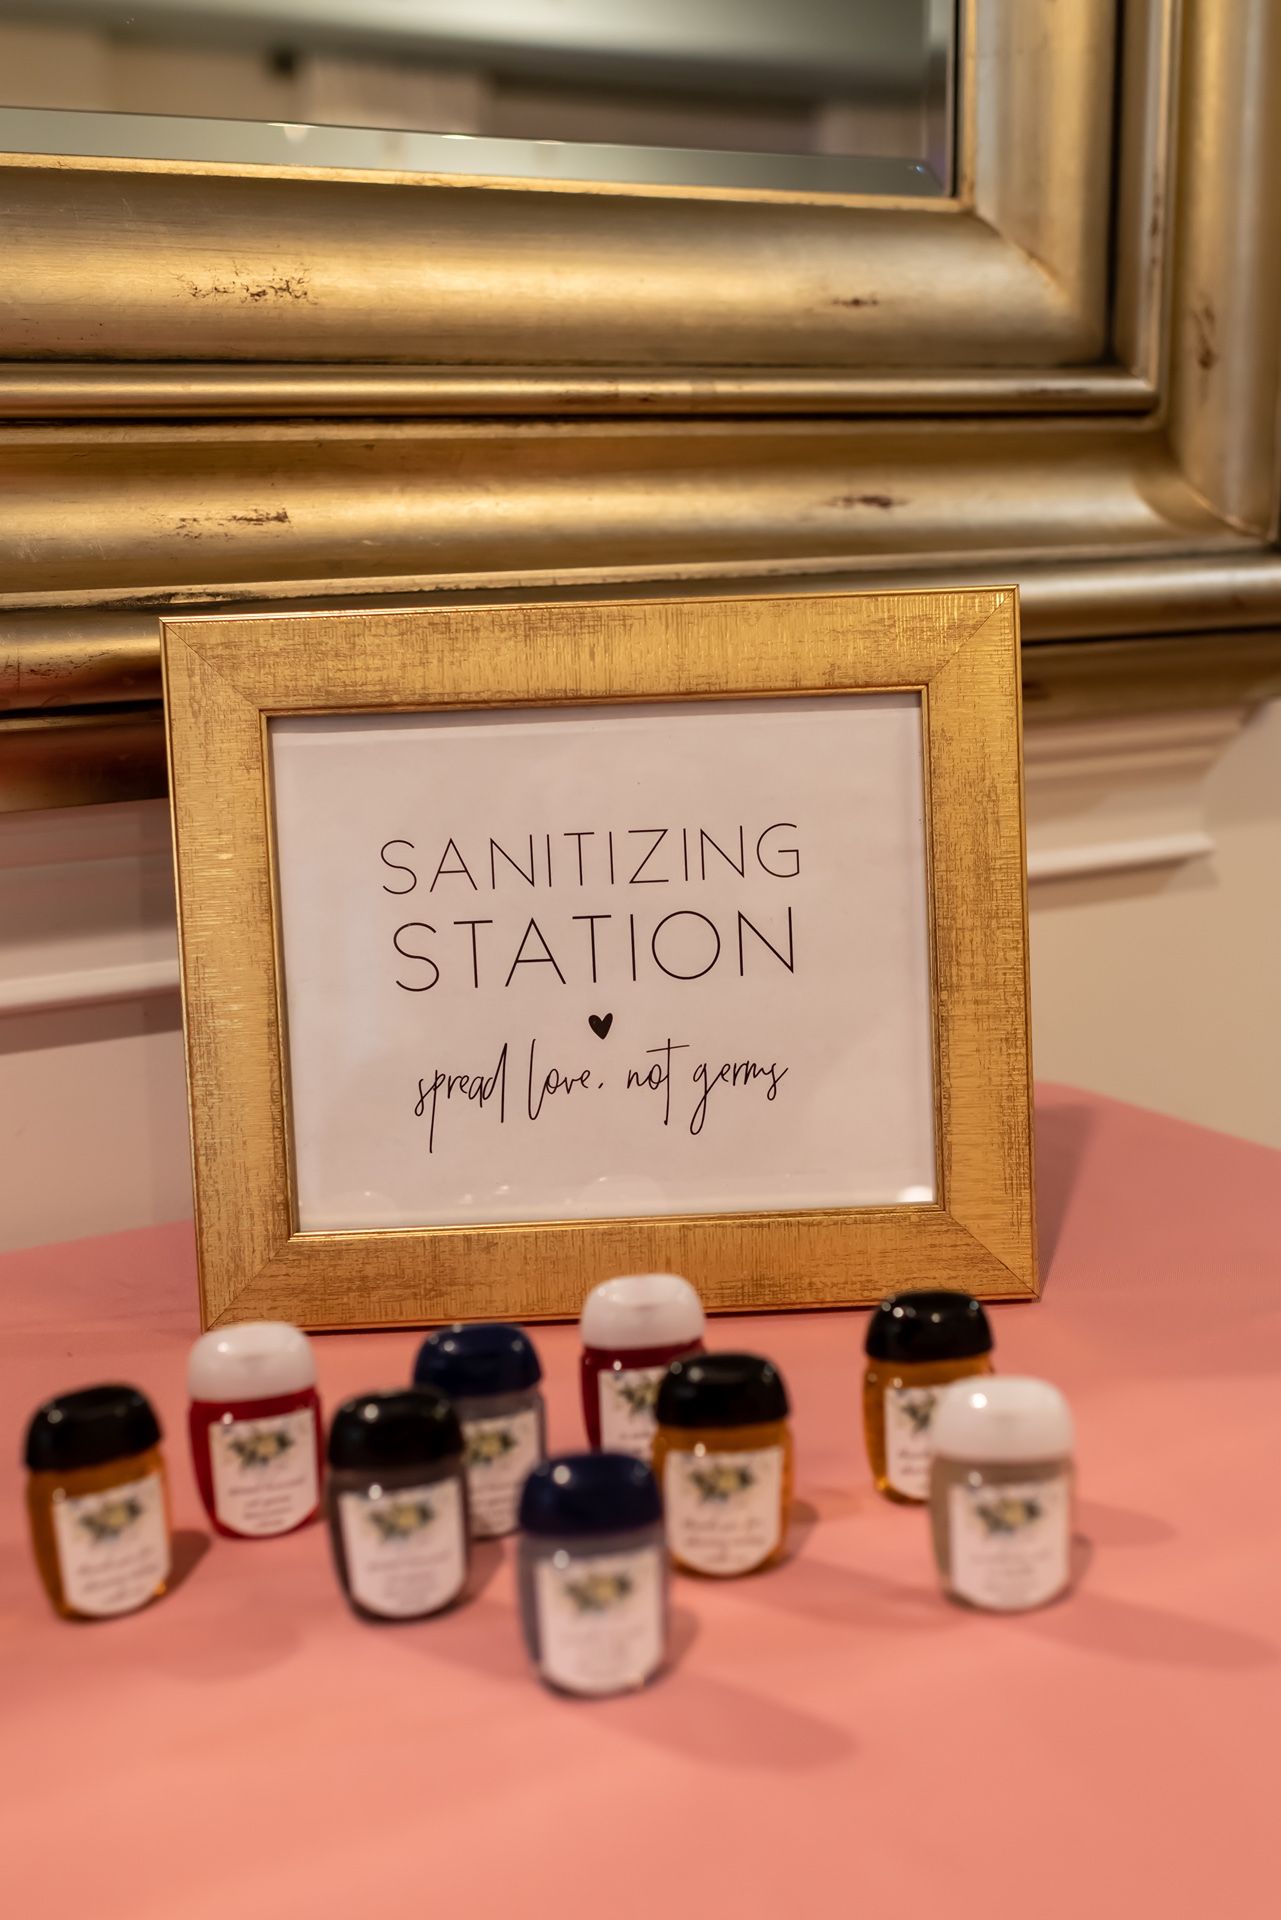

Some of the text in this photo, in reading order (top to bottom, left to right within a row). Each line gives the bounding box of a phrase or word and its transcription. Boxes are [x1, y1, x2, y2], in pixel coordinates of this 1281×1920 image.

[380, 822, 801, 895] SANITIZING
[392, 906, 795, 993] STATION
[413, 1042, 508, 1154] spread
[626, 1037, 691, 1127] not
[689, 1058, 789, 1136] germs
